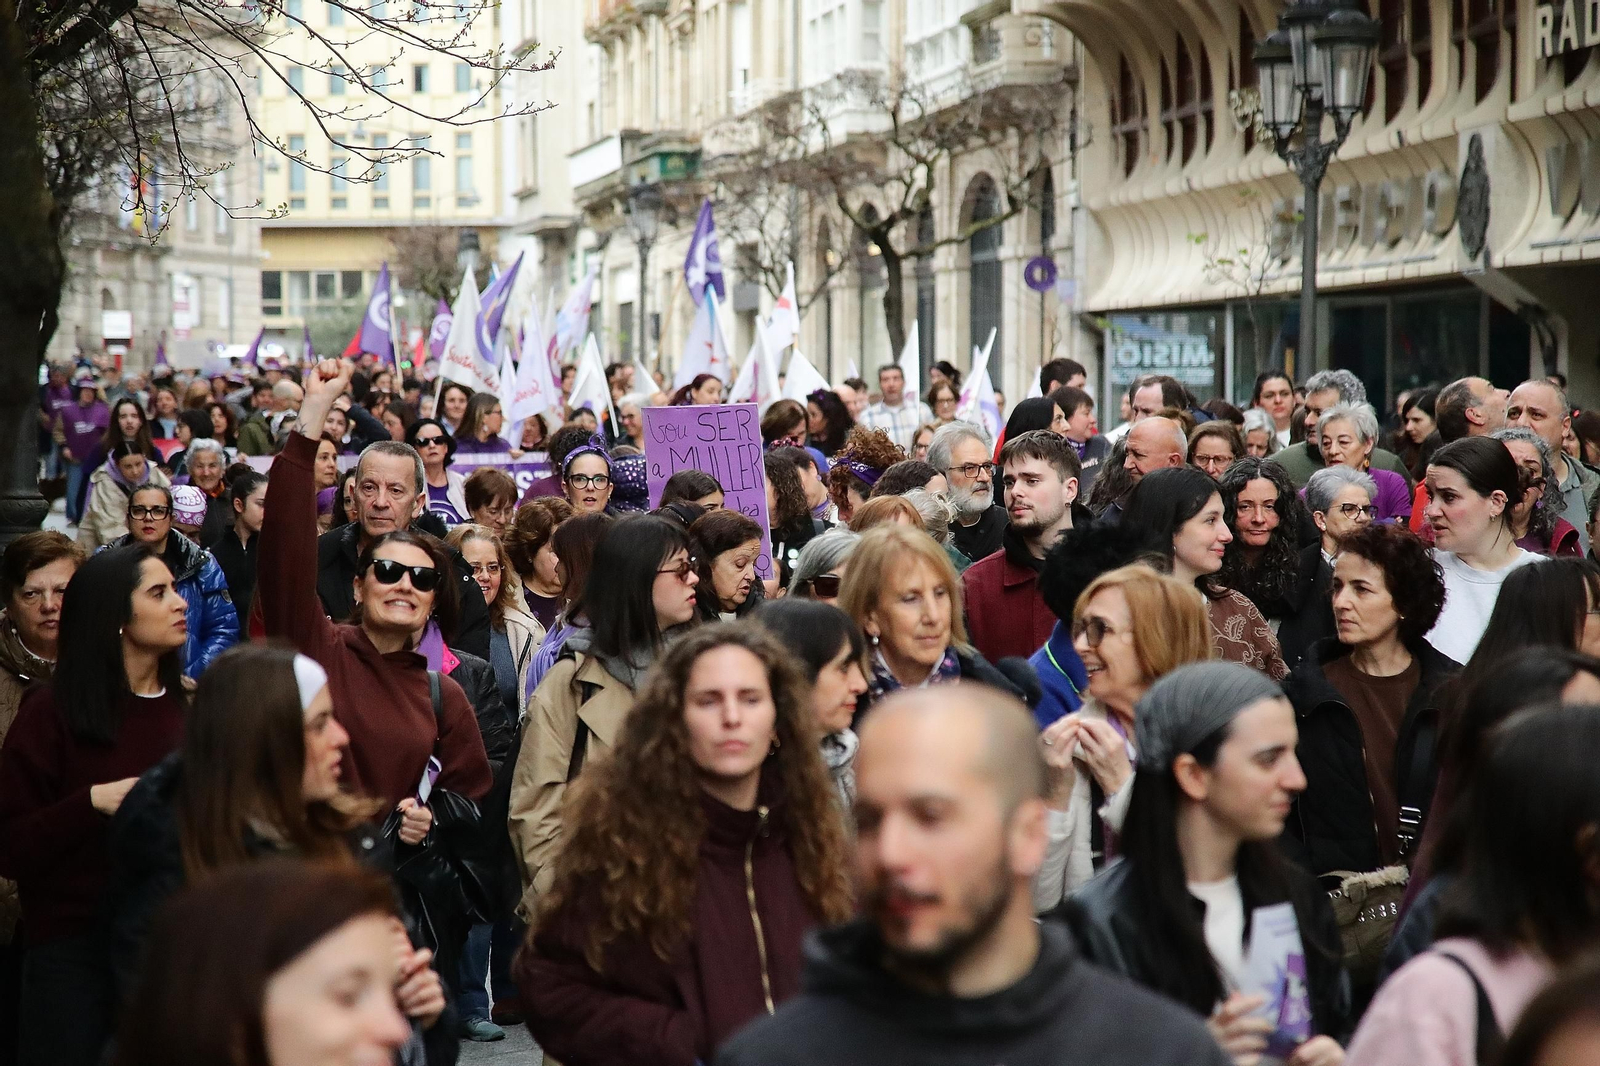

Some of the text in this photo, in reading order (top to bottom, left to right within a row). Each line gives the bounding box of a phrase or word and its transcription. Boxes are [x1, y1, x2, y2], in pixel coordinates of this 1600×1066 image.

[696, 408, 753, 442] SER
[651, 443, 764, 493] a MULLER
